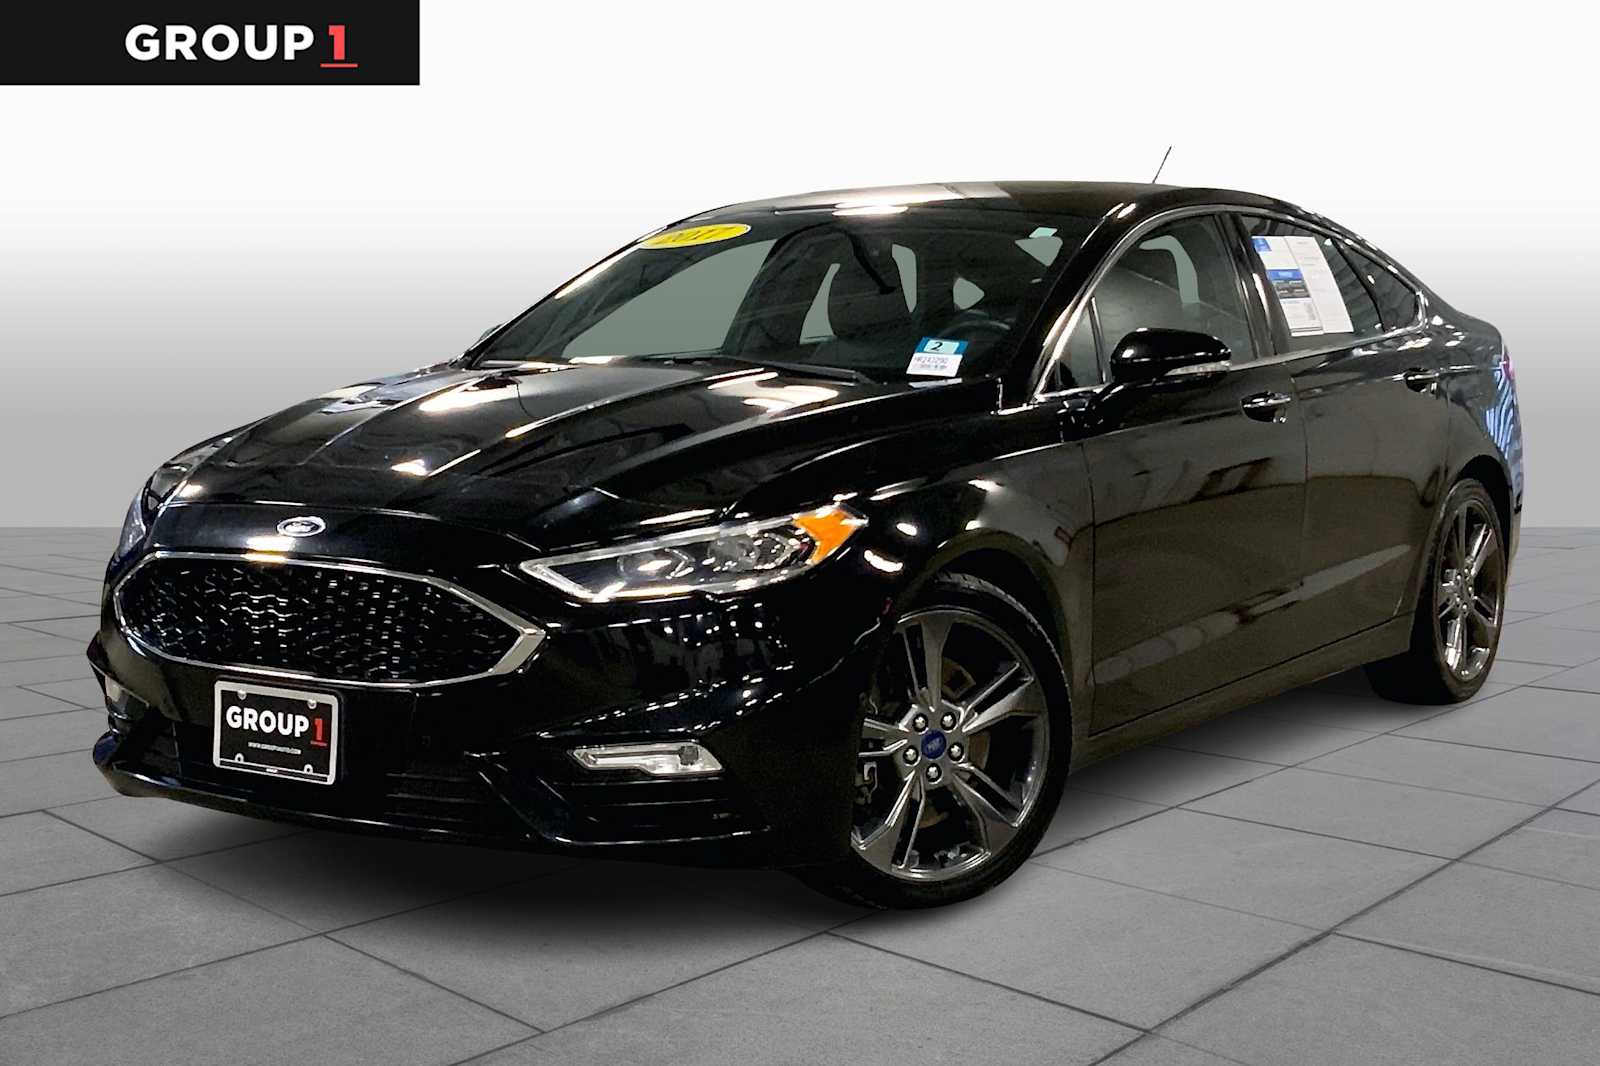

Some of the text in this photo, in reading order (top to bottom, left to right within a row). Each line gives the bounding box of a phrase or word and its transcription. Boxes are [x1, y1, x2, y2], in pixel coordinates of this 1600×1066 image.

[930, 341, 944, 351] 2
[226, 705, 323, 741] GROUP 1
